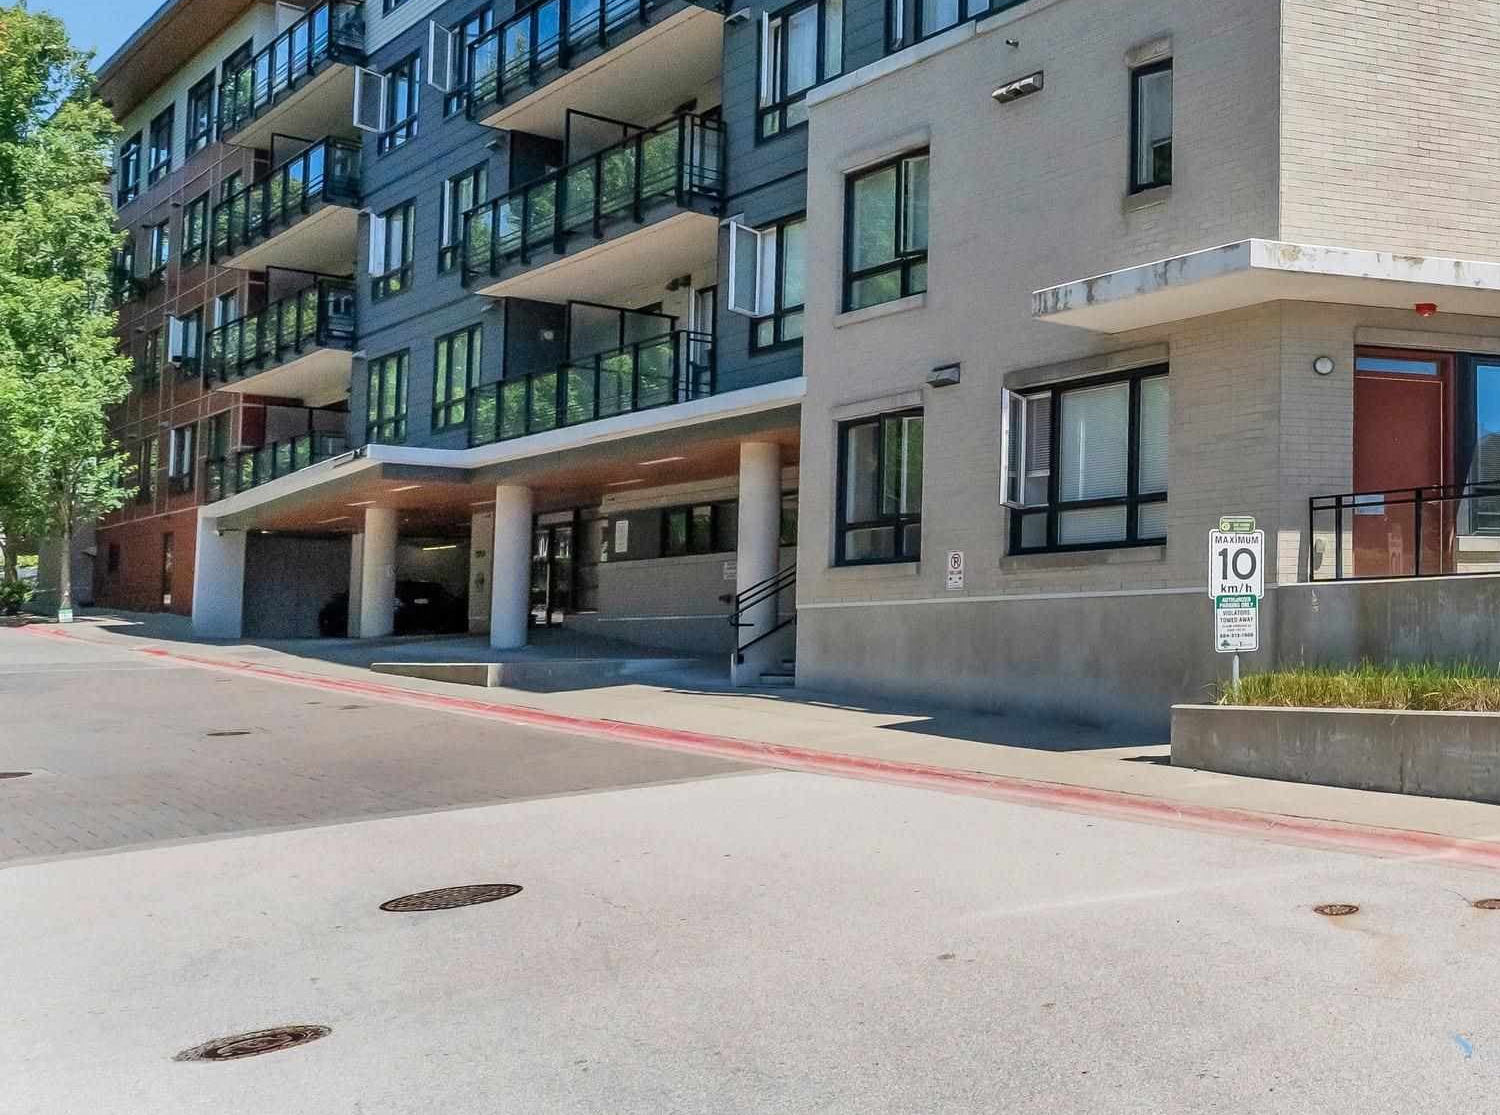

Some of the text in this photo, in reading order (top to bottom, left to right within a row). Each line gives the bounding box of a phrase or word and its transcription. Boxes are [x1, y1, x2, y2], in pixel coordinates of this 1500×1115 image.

[1215, 536, 1259, 544] MAXIMUM
[1219, 548, 1257, 580] 10
[1221, 583, 1252, 593] km/h
